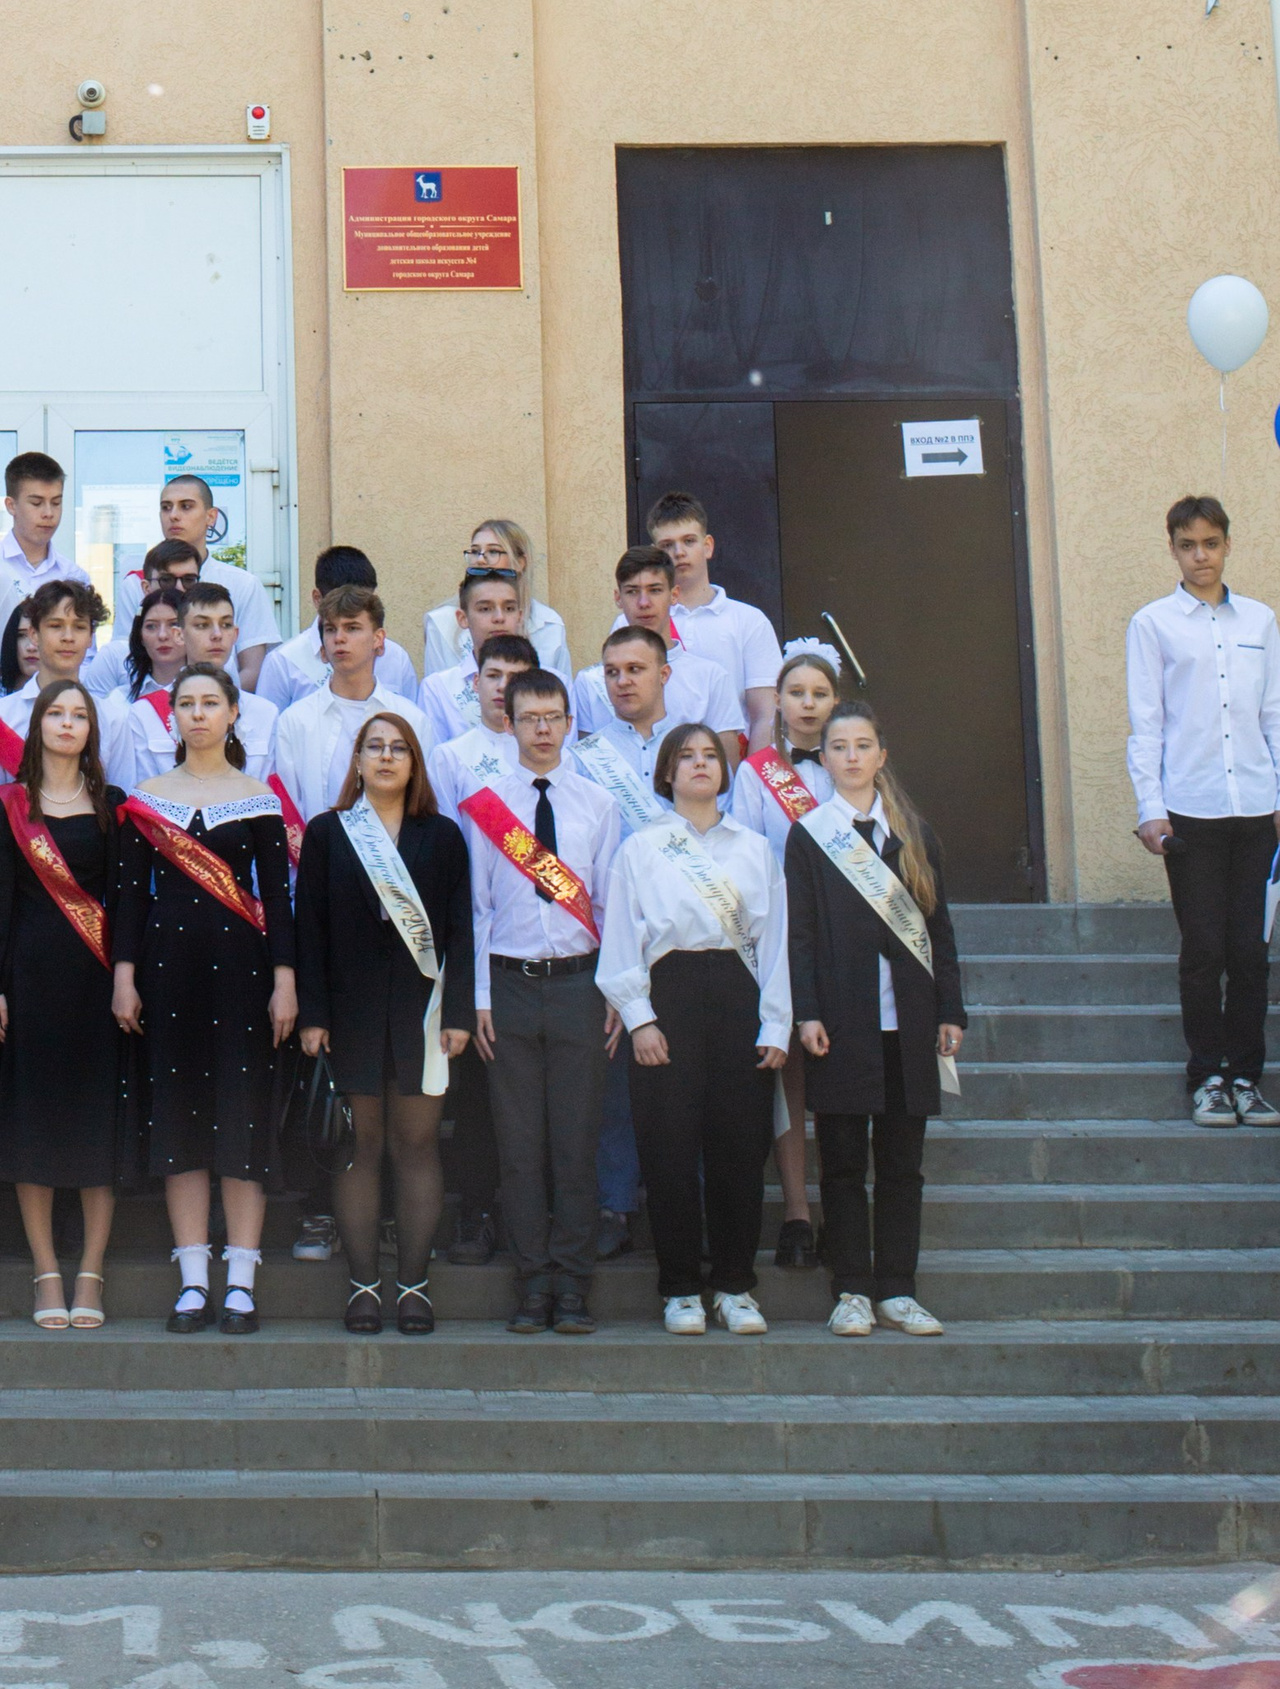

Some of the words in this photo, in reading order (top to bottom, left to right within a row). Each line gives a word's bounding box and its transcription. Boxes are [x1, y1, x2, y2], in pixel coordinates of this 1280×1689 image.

[348, 215, 412, 223] Администрация
[486, 214, 517, 223] Самара
[450, 270, 475, 280] Самара
[910, 436, 933, 444] ВХОД
[401, 913, 435, 954] 2024
